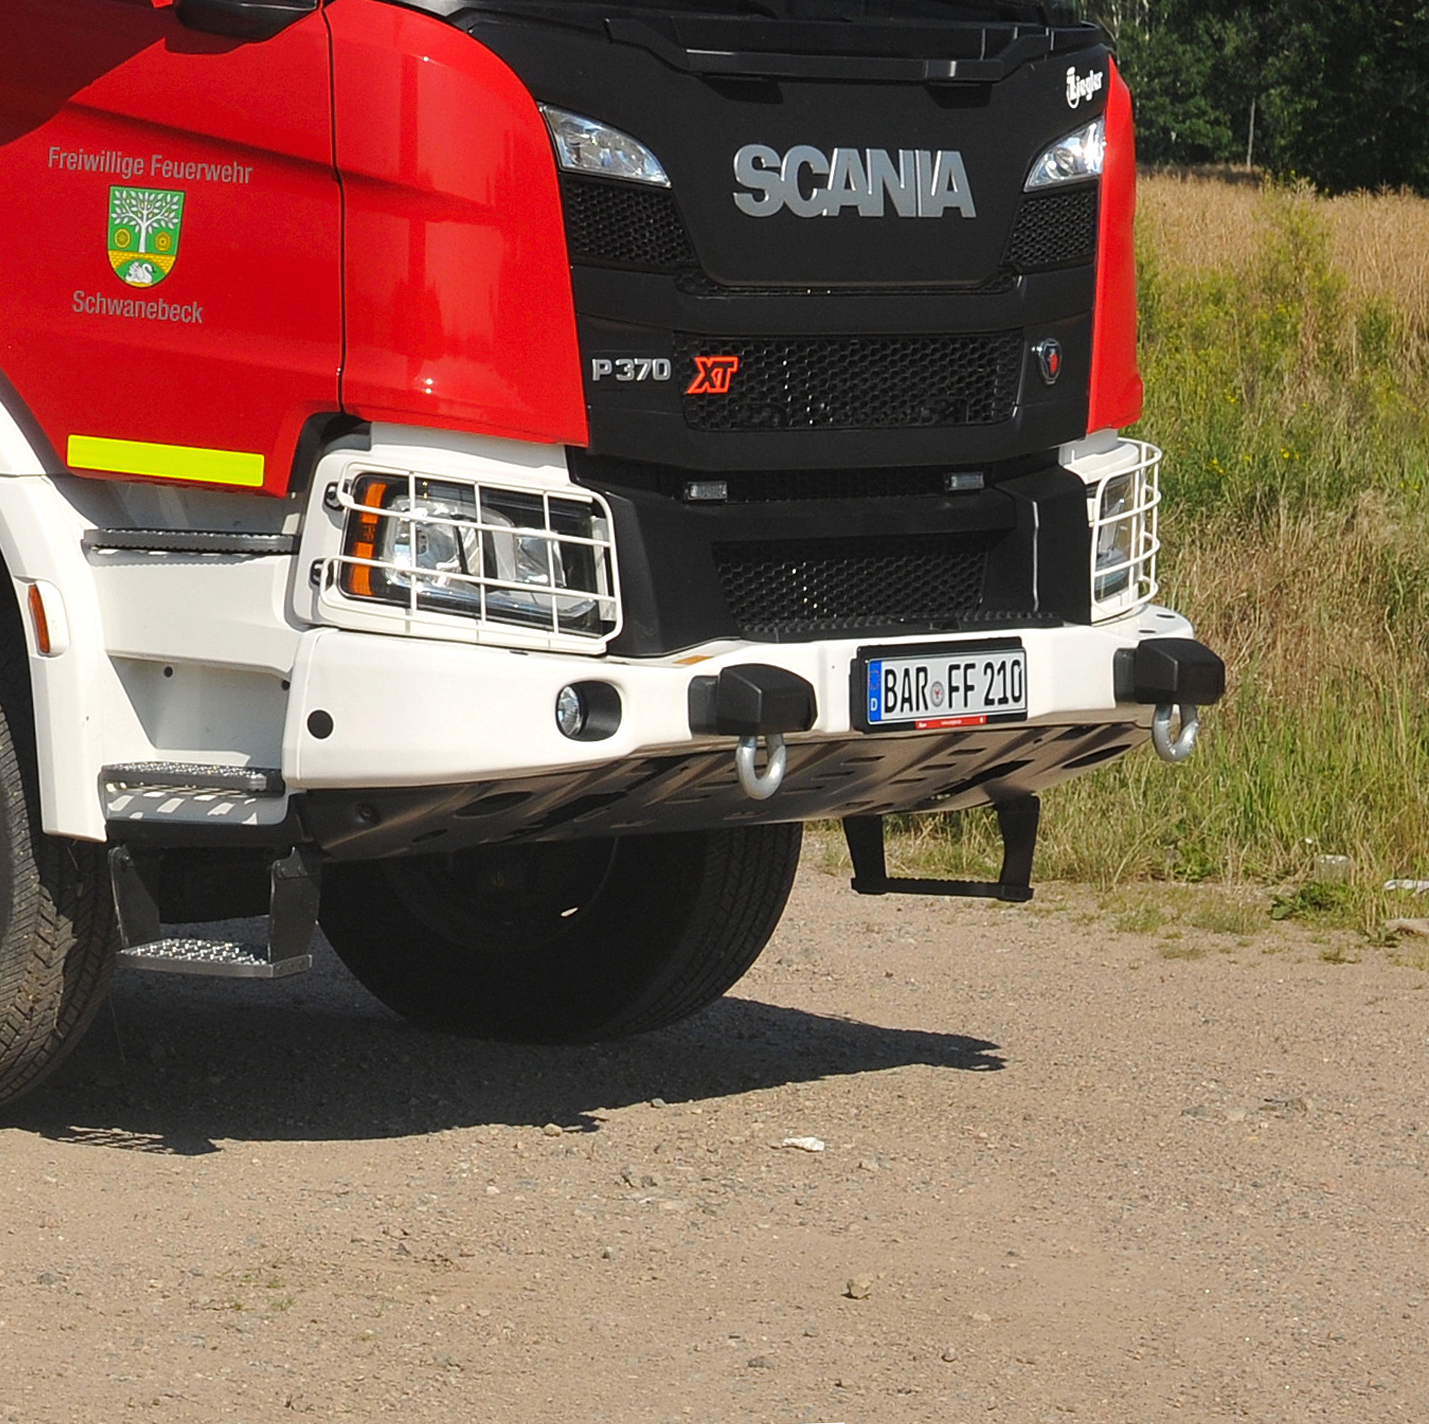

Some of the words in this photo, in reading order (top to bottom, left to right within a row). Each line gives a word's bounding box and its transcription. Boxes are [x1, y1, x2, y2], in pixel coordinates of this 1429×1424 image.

[48, 146, 145, 179] Freiwillige
[150, 154, 253, 184] Feuerwehr
[733, 144, 977, 218] SCANIA
[72, 290, 203, 324] Schwanebeck
[687, 355, 739, 394] XT
[884, 666, 929, 713] BAR
[948, 663, 976, 709] FF
[983, 659, 1022, 706] 210
